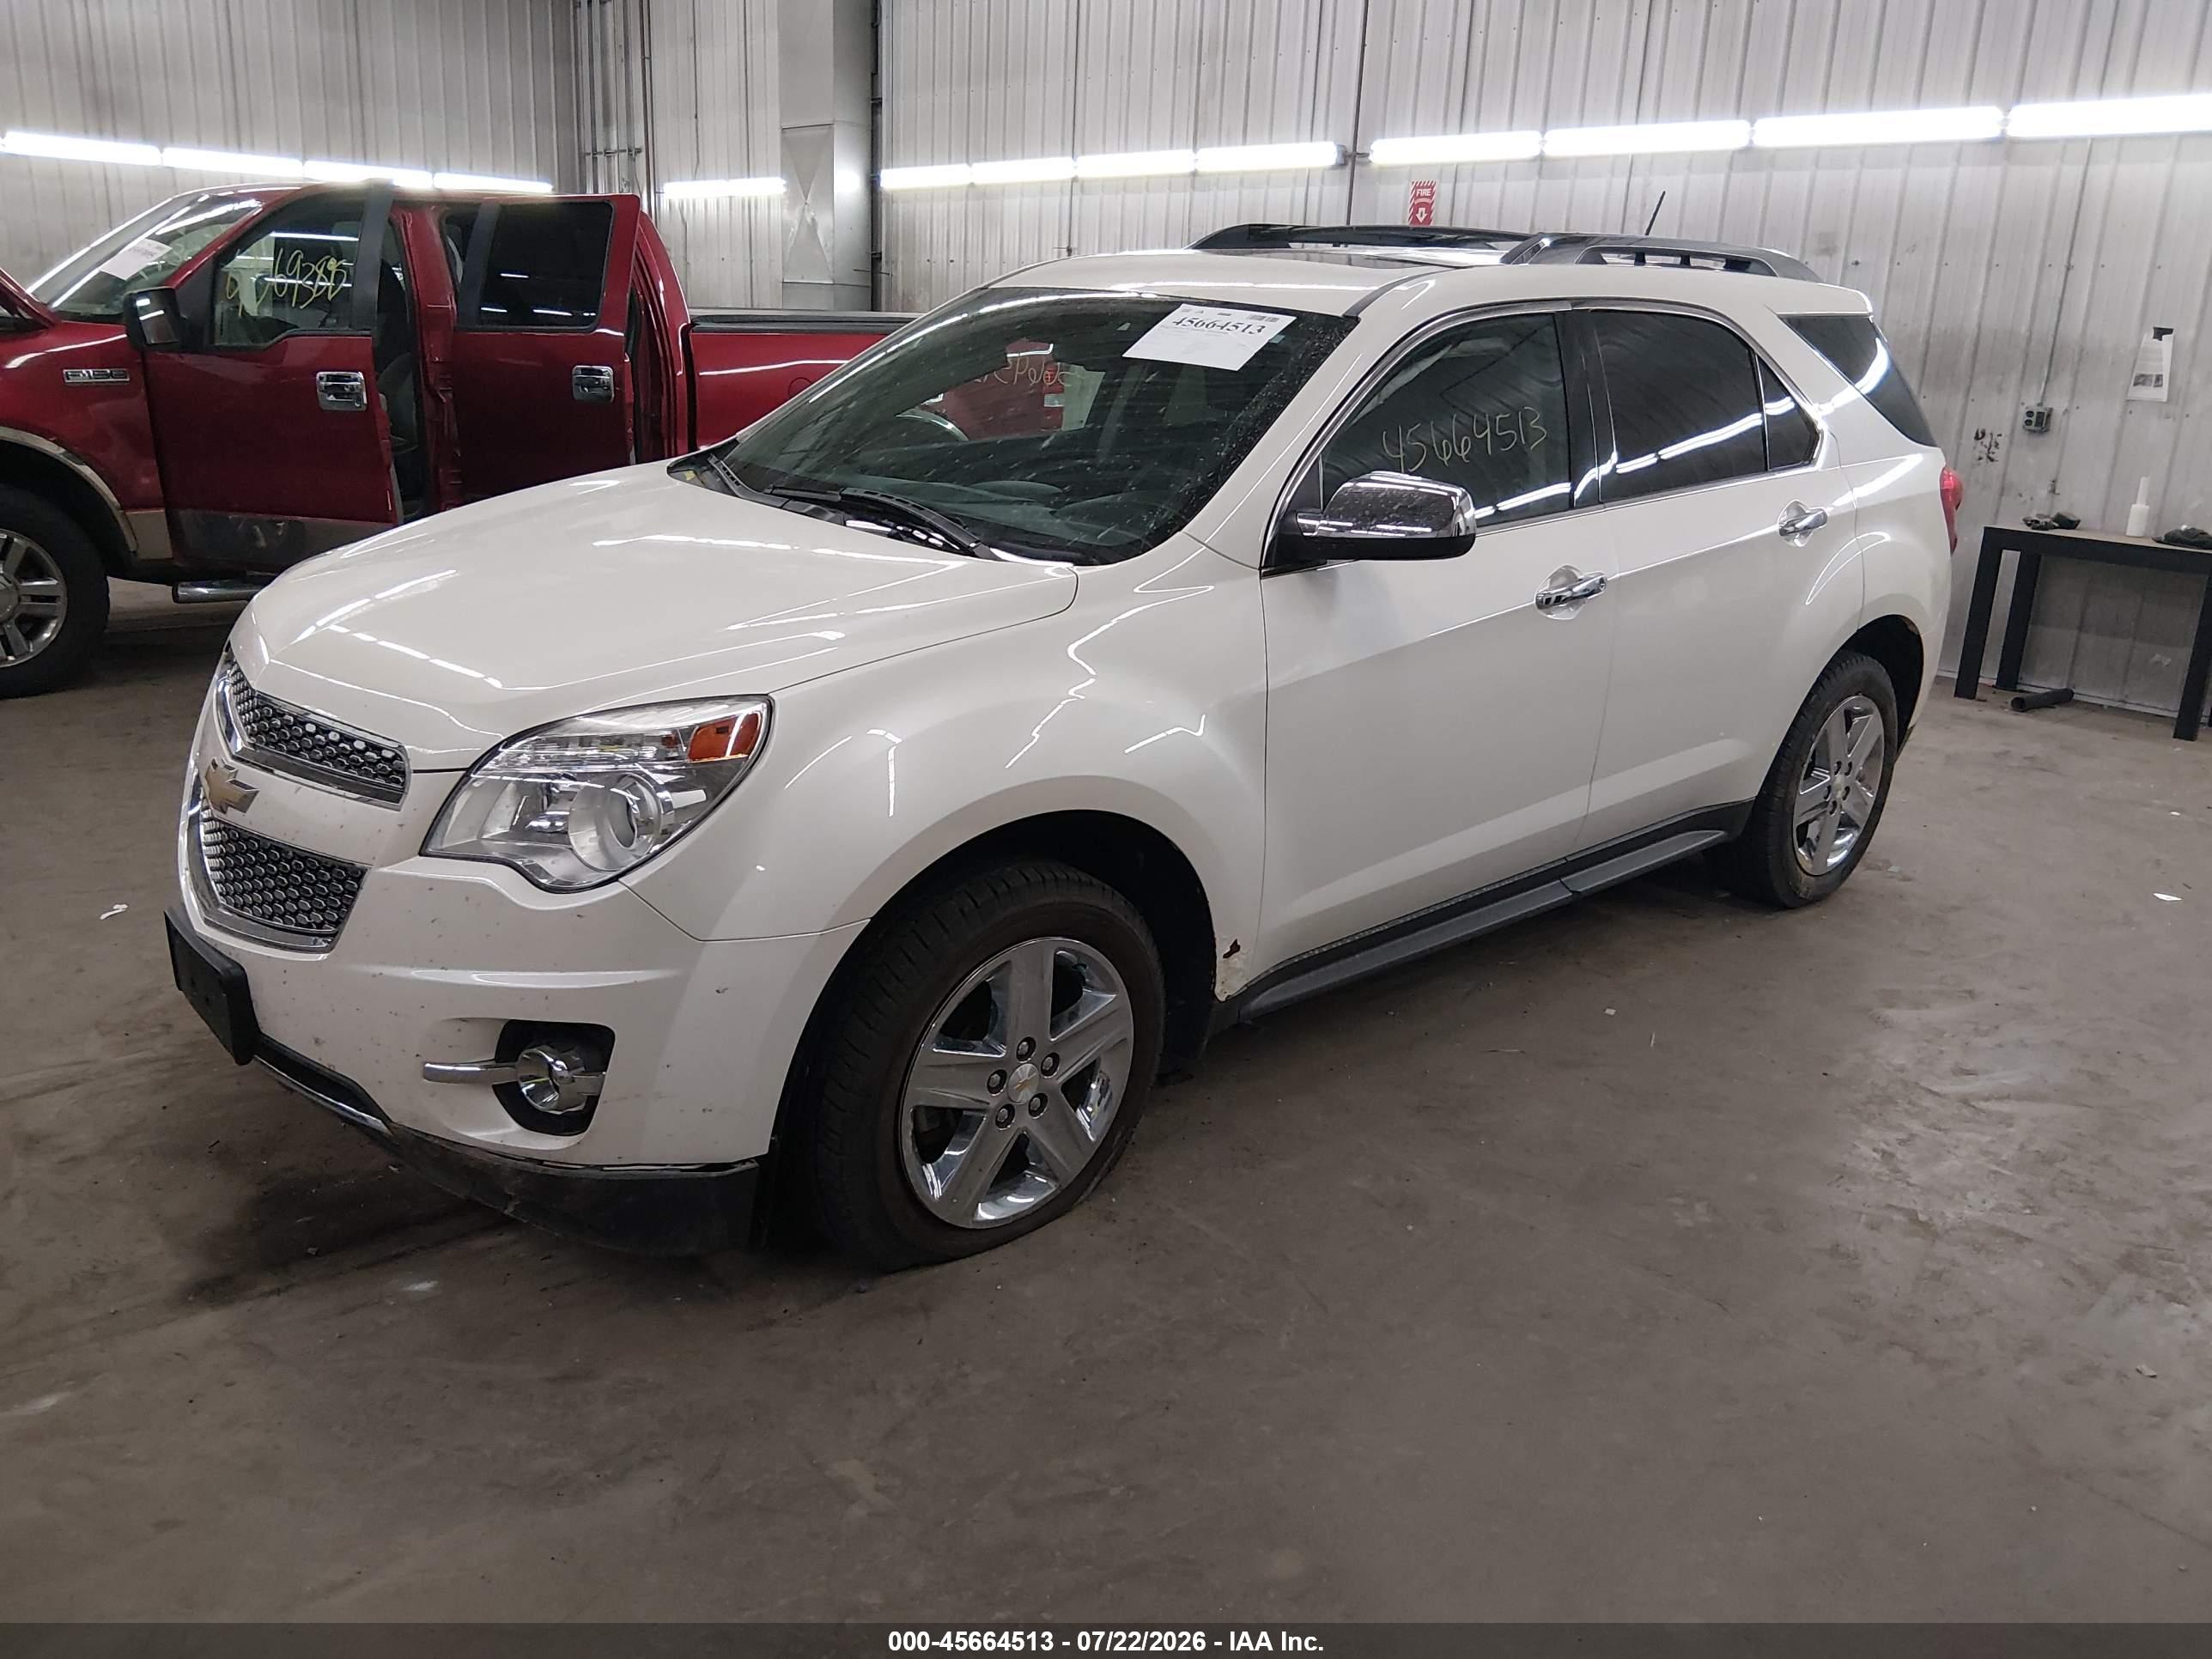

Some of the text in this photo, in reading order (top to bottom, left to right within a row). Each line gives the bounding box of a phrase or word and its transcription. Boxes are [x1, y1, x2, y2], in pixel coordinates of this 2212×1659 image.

[1416, 188, 1432, 197] FIRE
[1171, 316, 1267, 335] 45664513
[1382, 406, 1547, 473] 45664513
